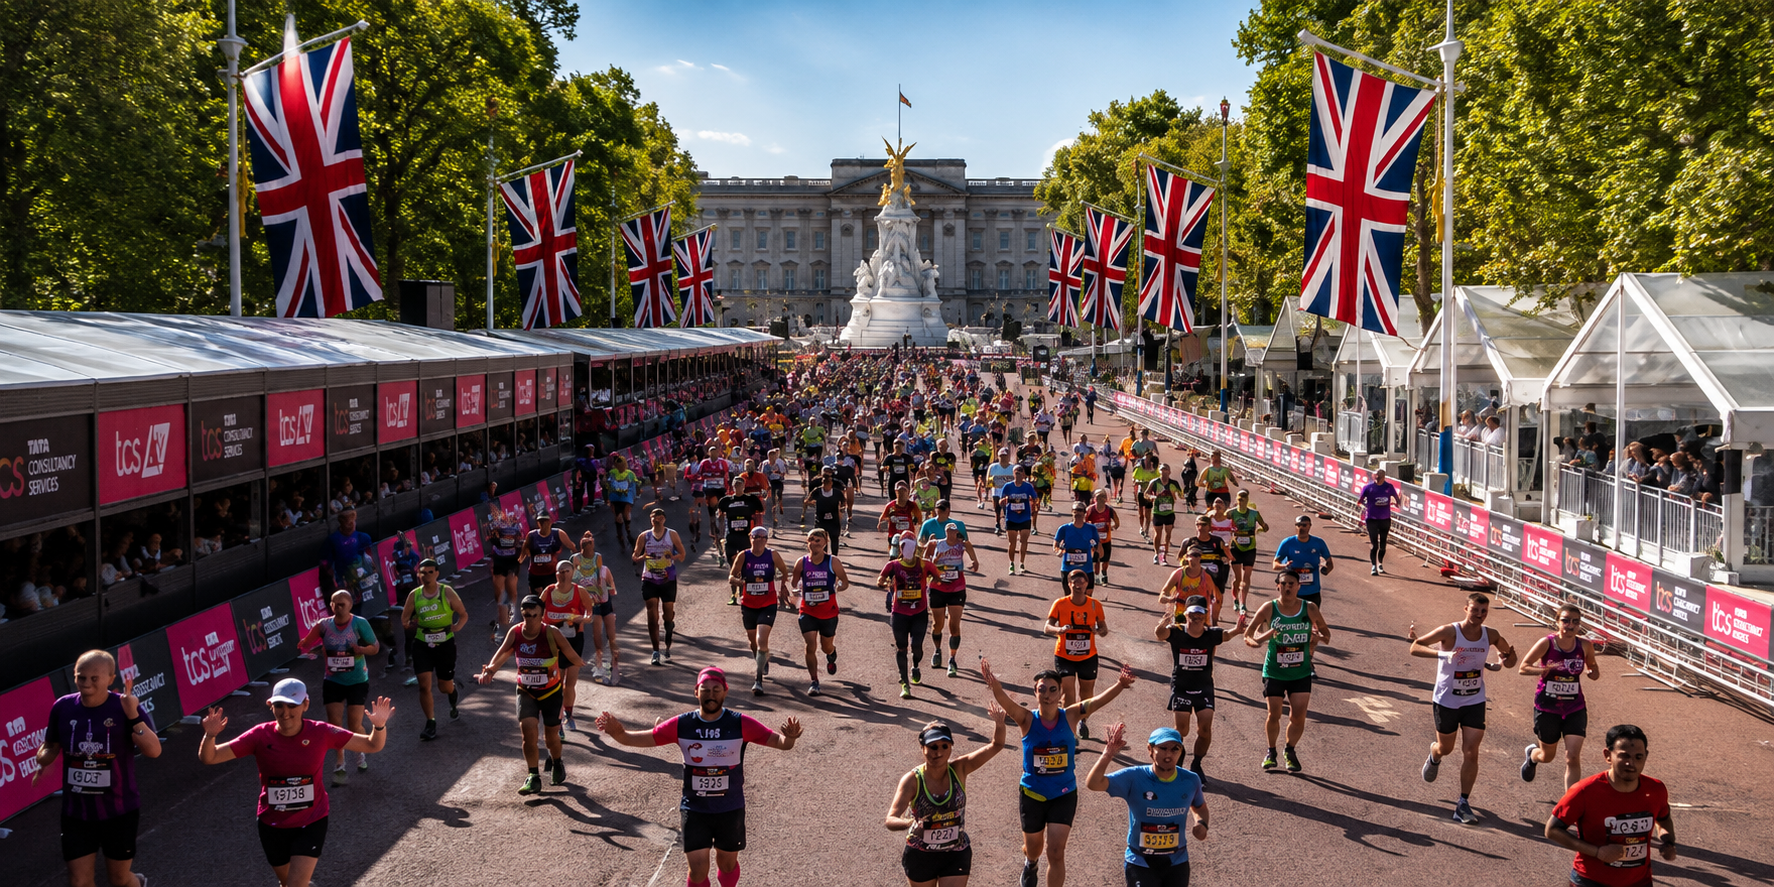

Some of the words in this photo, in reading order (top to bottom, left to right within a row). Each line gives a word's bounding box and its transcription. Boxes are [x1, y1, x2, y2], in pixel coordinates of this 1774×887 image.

[27, 438, 50, 455] TATA
[116, 430, 141, 477] tcs
[201, 420, 223, 462] tcs
[28, 476, 59, 496] SERVICES
[1712, 600, 1732, 636] tcs
[181, 646, 211, 686] tcs
